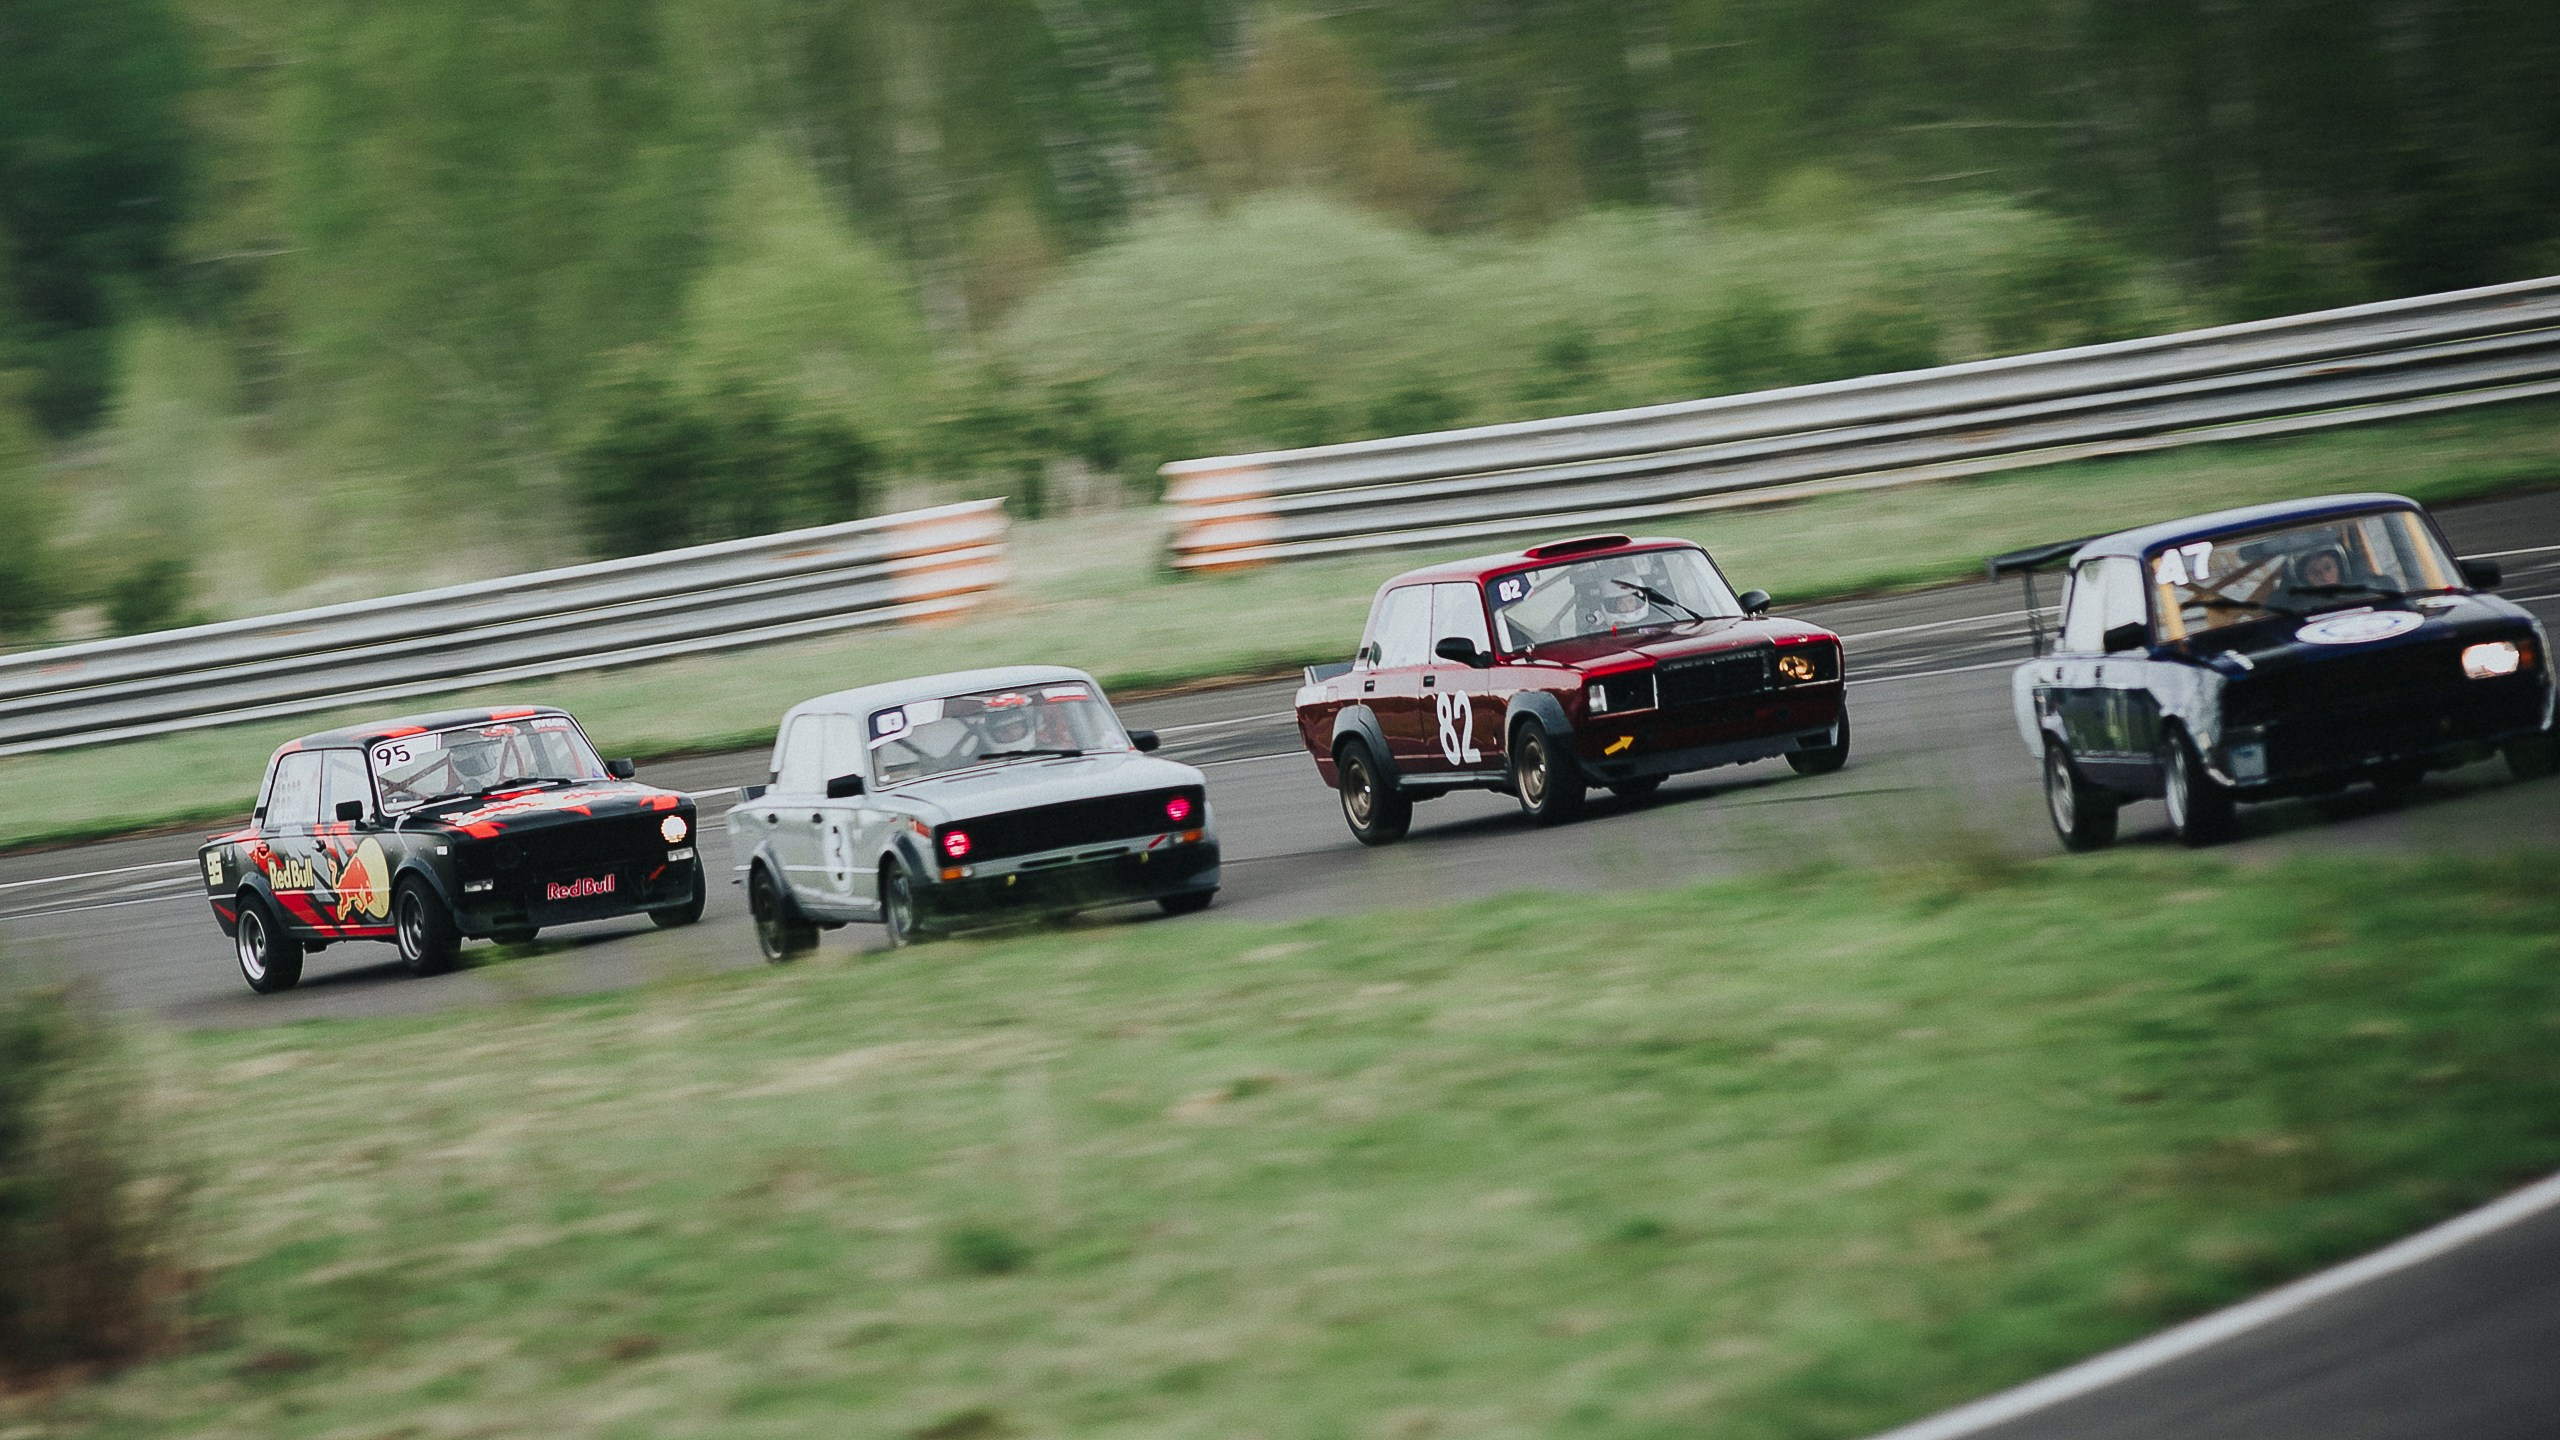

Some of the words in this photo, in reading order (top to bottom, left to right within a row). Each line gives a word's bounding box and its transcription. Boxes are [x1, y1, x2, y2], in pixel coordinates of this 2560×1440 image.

[2155, 541, 2214, 586] 47
[1499, 579, 1523, 601] 82
[1437, 690, 1482, 766] 82
[376, 744, 411, 767] 95
[206, 851, 224, 886] 95
[267, 858, 291, 890] Red
[291, 857, 315, 888] Bull
[547, 879, 581, 900] Red
[583, 873, 615, 896] Bull
